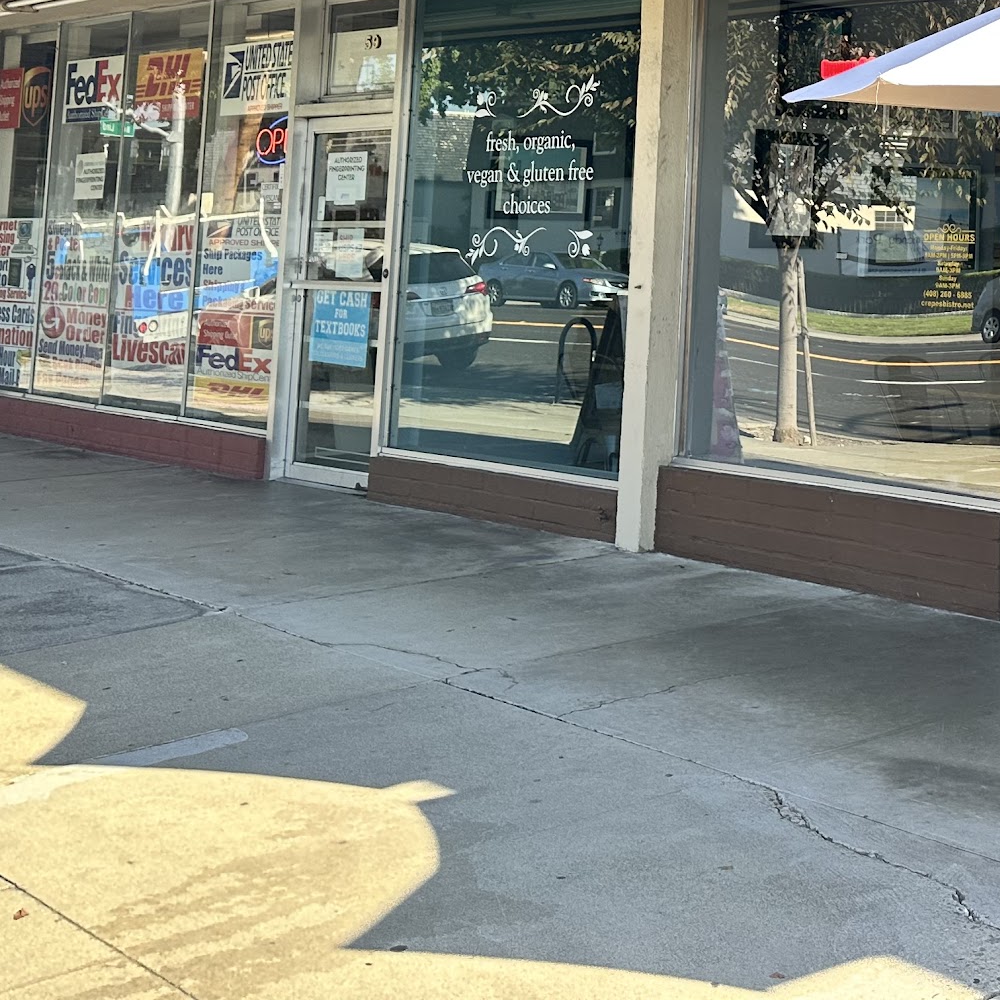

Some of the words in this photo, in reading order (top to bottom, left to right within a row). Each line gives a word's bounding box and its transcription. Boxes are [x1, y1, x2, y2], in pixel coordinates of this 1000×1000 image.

[245, 44, 272, 71] UNITED
[65, 59, 122, 106] FedEx
[242, 74, 261, 101] POST
[260, 72, 287, 100] OFFICE
[23, 85, 49, 118] ups
[486, 130, 520, 154] fresh,
[523, 130, 576, 154] organic,
[466, 168, 503, 188] vegan
[507, 162, 519, 183] &
[523, 160, 565, 188] gluten
[567, 159, 594, 182] free
[502, 193, 551, 215] choices
[236, 227, 254, 237] POST
[923, 233, 945, 241] OPEN
[946, 233, 976, 242] HOURS
[209, 238, 249, 247] APPROVED
[204, 248, 222, 260] Ship
[224, 248, 263, 261] Packages
[203, 263, 224, 276] Here
[124, 284, 184, 311] Here
[316, 289, 338, 305] GET
[339, 290, 369, 308] CASH
[921, 300, 975, 309] crepesbistro.net
[11, 304, 35, 325] Cards
[66, 307, 107, 329] Money
[334, 308, 348, 319] FOR
[66, 324, 106, 344] Order
[315, 319, 367, 337] TEXTBOOKS
[38, 338, 58, 354] Send
[196, 344, 272, 375] FedEx
[207, 382, 265, 398] DHL
